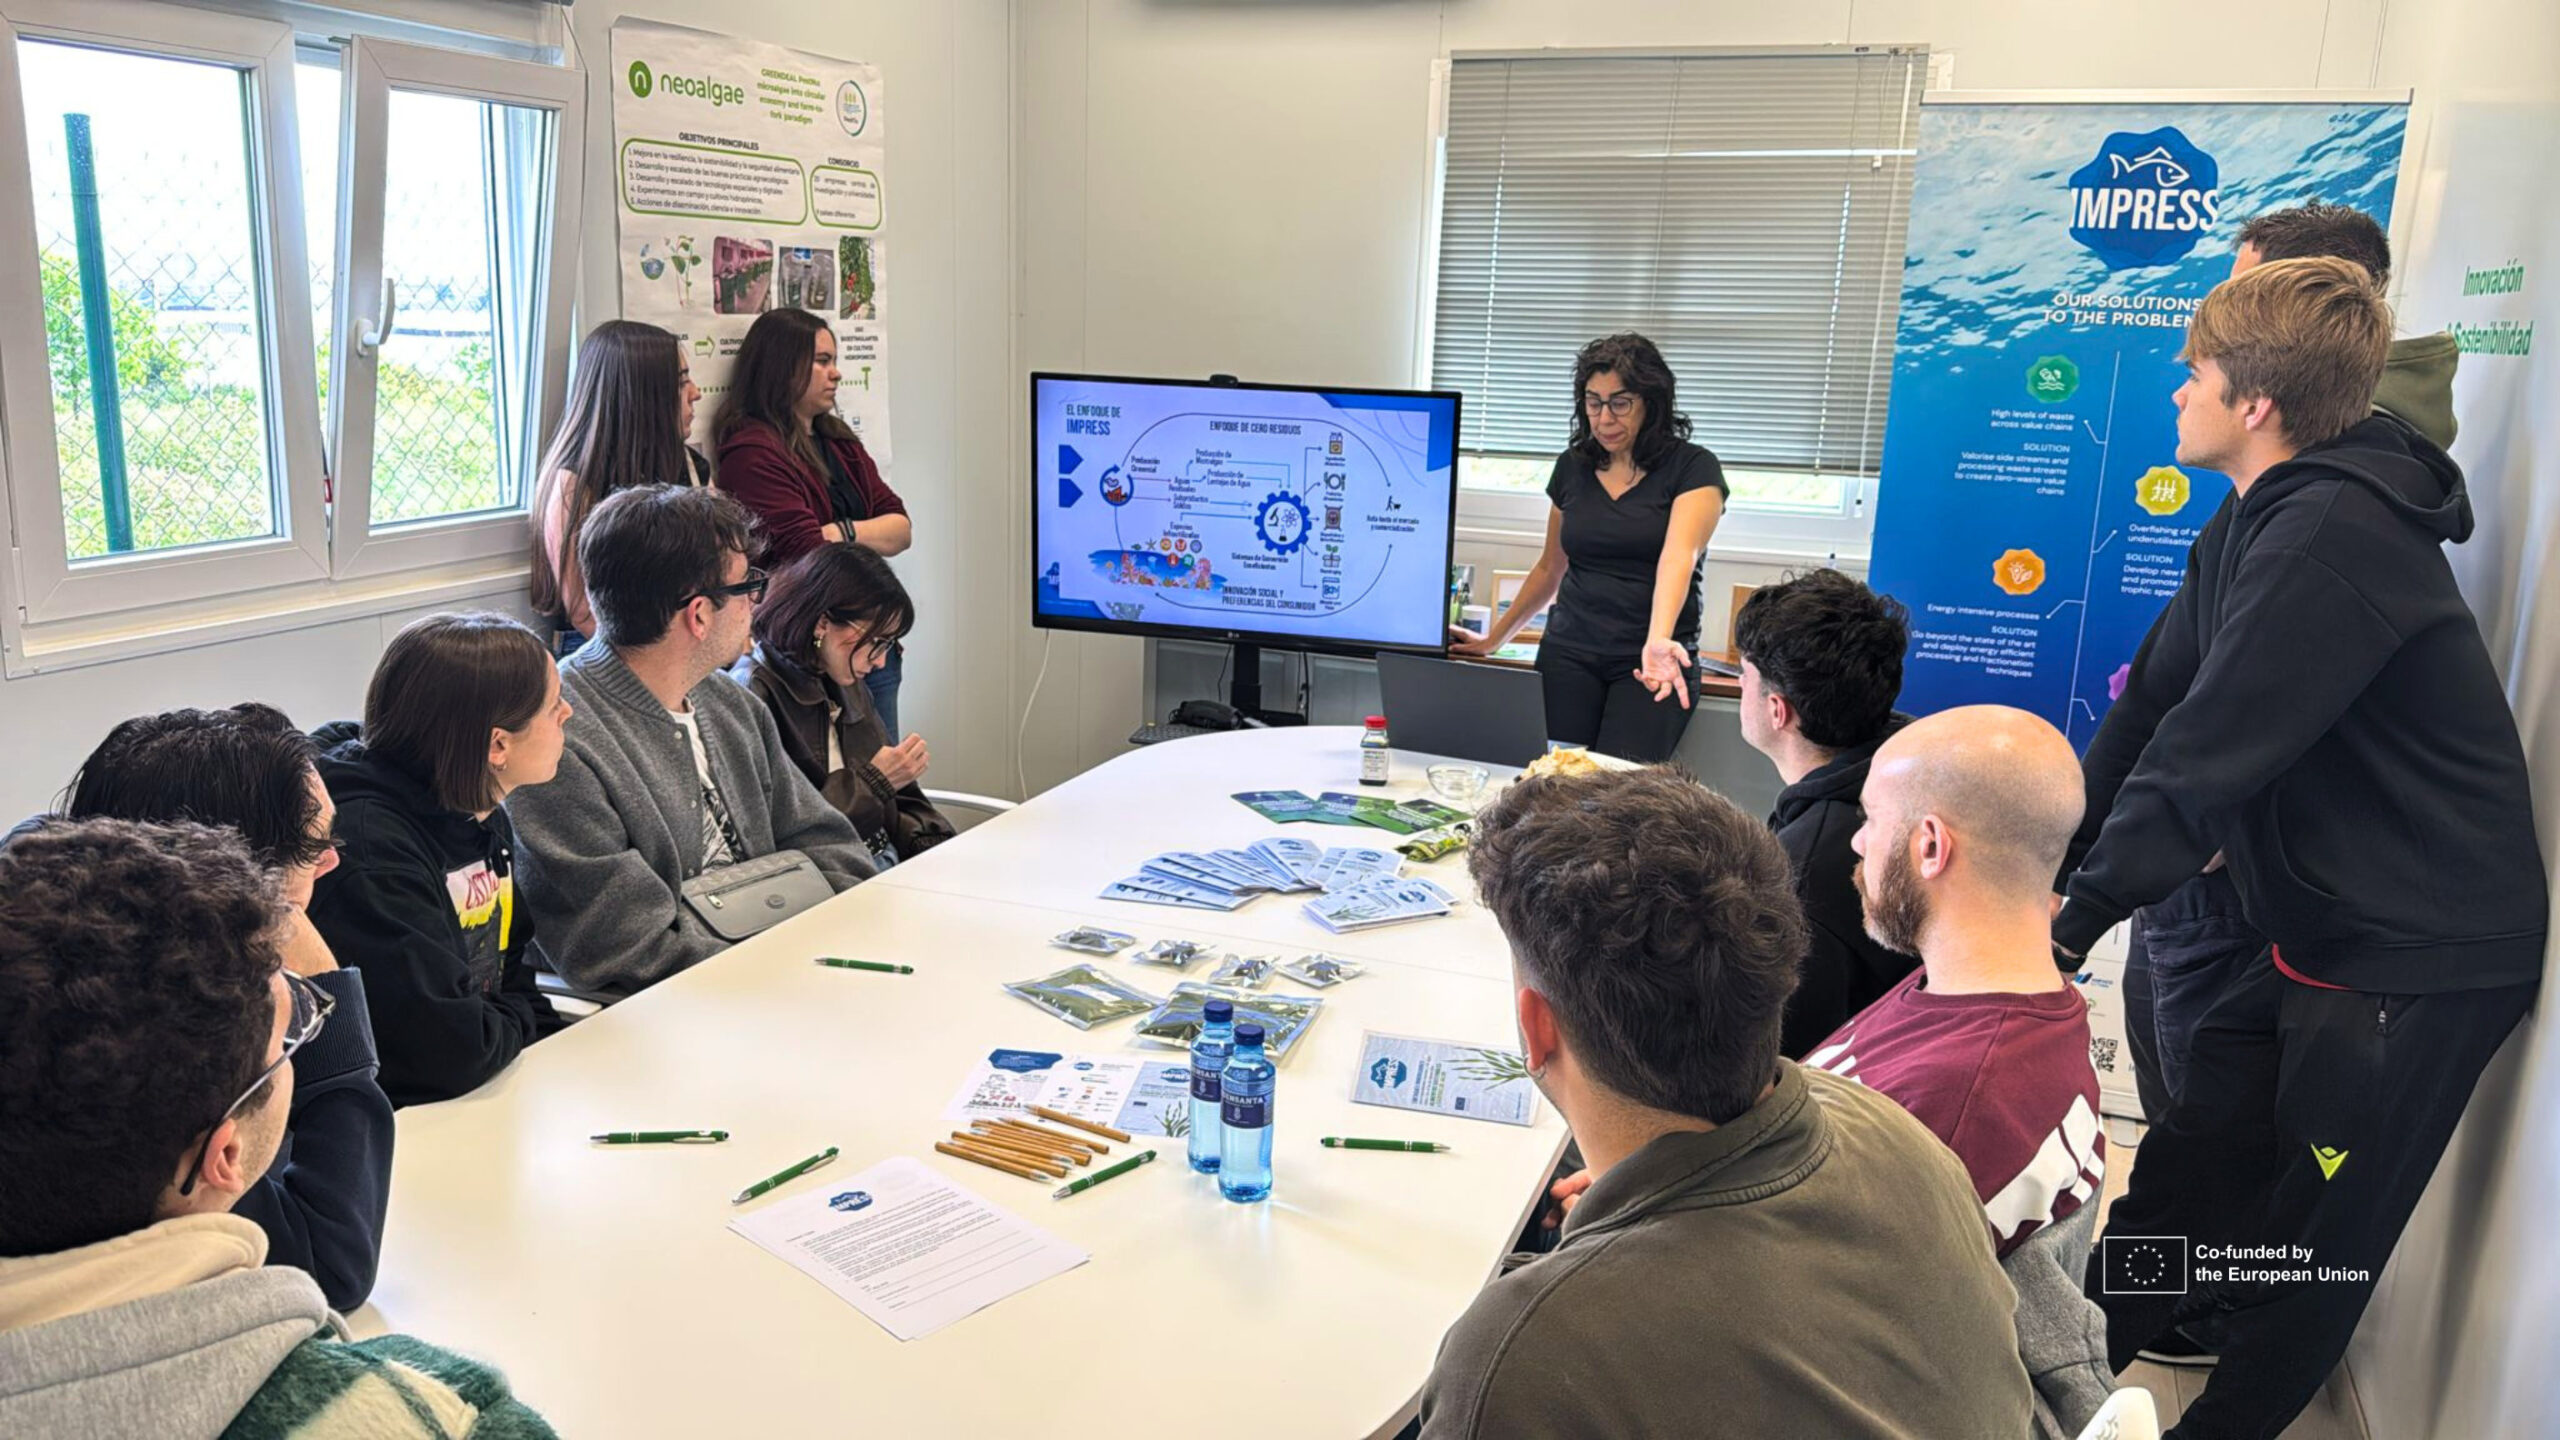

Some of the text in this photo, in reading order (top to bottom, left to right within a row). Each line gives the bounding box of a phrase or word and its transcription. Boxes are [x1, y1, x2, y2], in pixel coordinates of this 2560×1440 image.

[660, 74, 744, 106] neoalgae
[679, 132, 759, 151] OBJETIVOS PRINCIPALES
[2069, 187, 2219, 232] IMPRESS
[2463, 257, 2524, 296] Innovación
[2053, 294, 2202, 311] OUR SOLUTIONS
[2043, 309, 2066, 323] TO
[2073, 311, 2106, 324] THE
[2454, 320, 2533, 356] Sostenibilidad
[1066, 404, 1121, 418] EL ENFOQUE DE
[1991, 409, 2075, 421] High levels of waste
[1066, 419, 1111, 436] IMPRESS
[1210, 421, 1301, 435] ENFOQUE DE CERO RESIDUOS
[1990, 420, 2073, 431] across value chains
[2023, 442, 2071, 453] SOLUTION
[1961, 451, 2069, 465] Valorise side streams and
[1958, 462, 2067, 476] processing waste streams
[1965, 472, 1992, 481] create
[2043, 477, 2066, 485] value
[2036, 486, 2065, 496] chains
[2129, 523, 2179, 537] Overfishing
[2180, 528, 2190, 536] of
[2125, 553, 2173, 564] SOLUTION
[2123, 564, 2159, 576] Develop
[2140, 577, 2178, 587] promote
[1222, 585, 1256, 597] INNOVACIÓN
[1258, 588, 1279, 598] SOCIAL
[2121, 585, 2152, 596] trophic
[1222, 597, 1264, 608] PREFERENCIAS
[1265, 600, 1276, 608] DEL
[1277, 600, 1316, 611] CONSUMIDOR
[1927, 603, 2040, 620] Energy intensive processes
[1991, 625, 2038, 637] SOLUTION
[1911, 630, 1924, 639] Go
[1925, 632, 1957, 642] beyond
[1958, 634, 1973, 643] the
[1974, 636, 1996, 645] state
[2008, 639, 2022, 647] the
[2023, 641, 2036, 649] art
[1922, 641, 2035, 658] and deploy energy efficient
[1915, 651, 1961, 663] processing
[1980, 655, 2034, 668] fractionation
[1985, 666, 2032, 678] techniques
